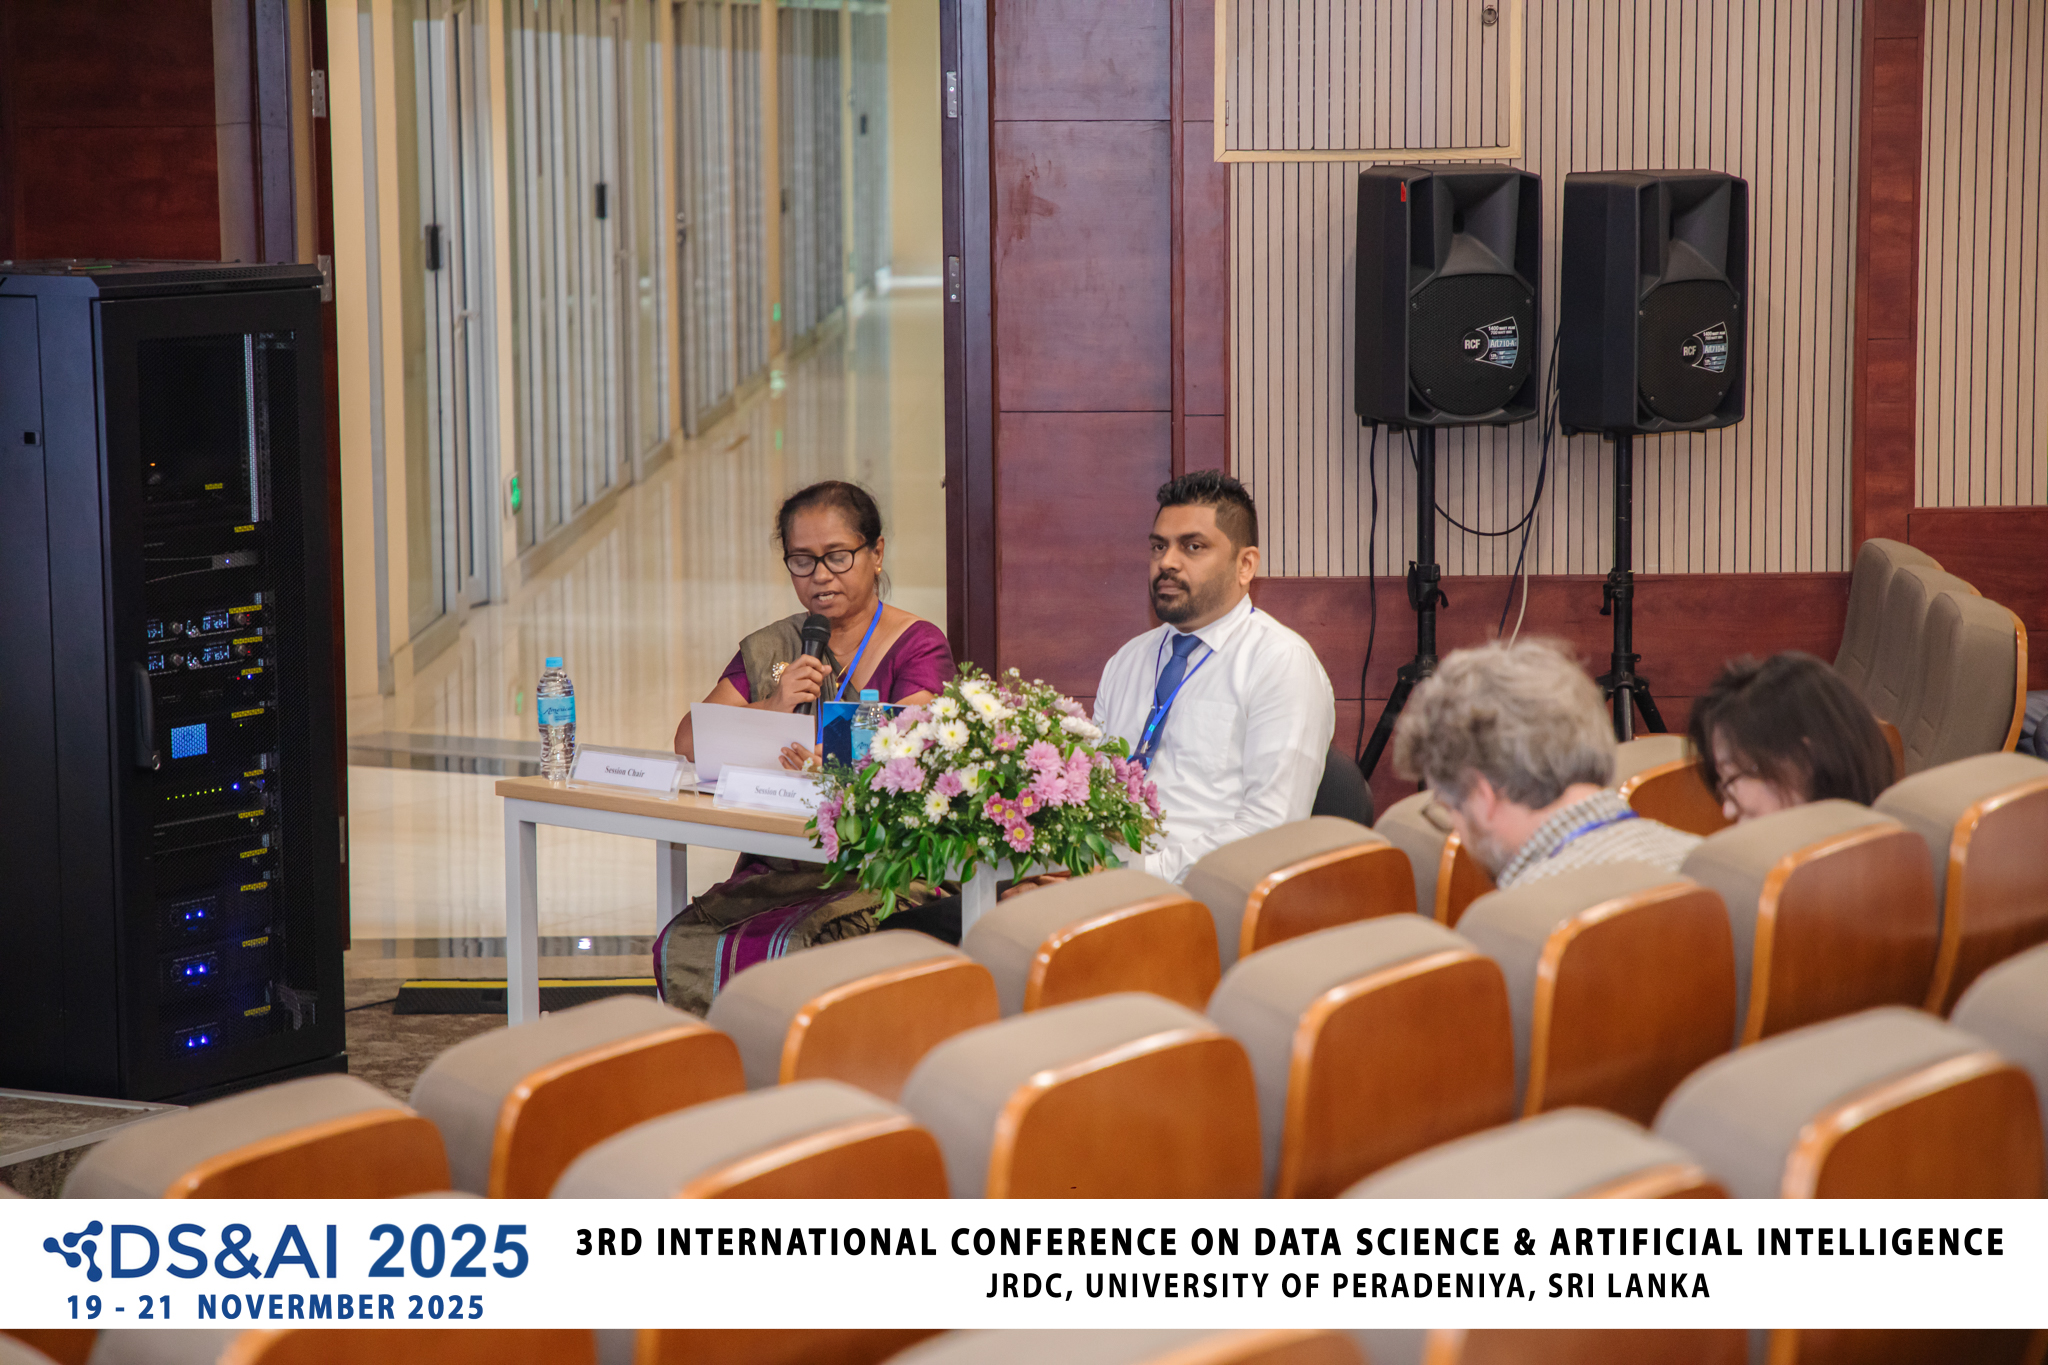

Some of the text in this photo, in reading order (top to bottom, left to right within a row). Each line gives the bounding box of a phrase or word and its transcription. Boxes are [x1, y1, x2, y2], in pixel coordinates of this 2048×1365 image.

[1464, 339, 1480, 349] RCF
[1683, 345, 1696, 356] RCF
[605, 765, 645, 778] Session Chair
[754, 785, 797, 798] Session Chair
